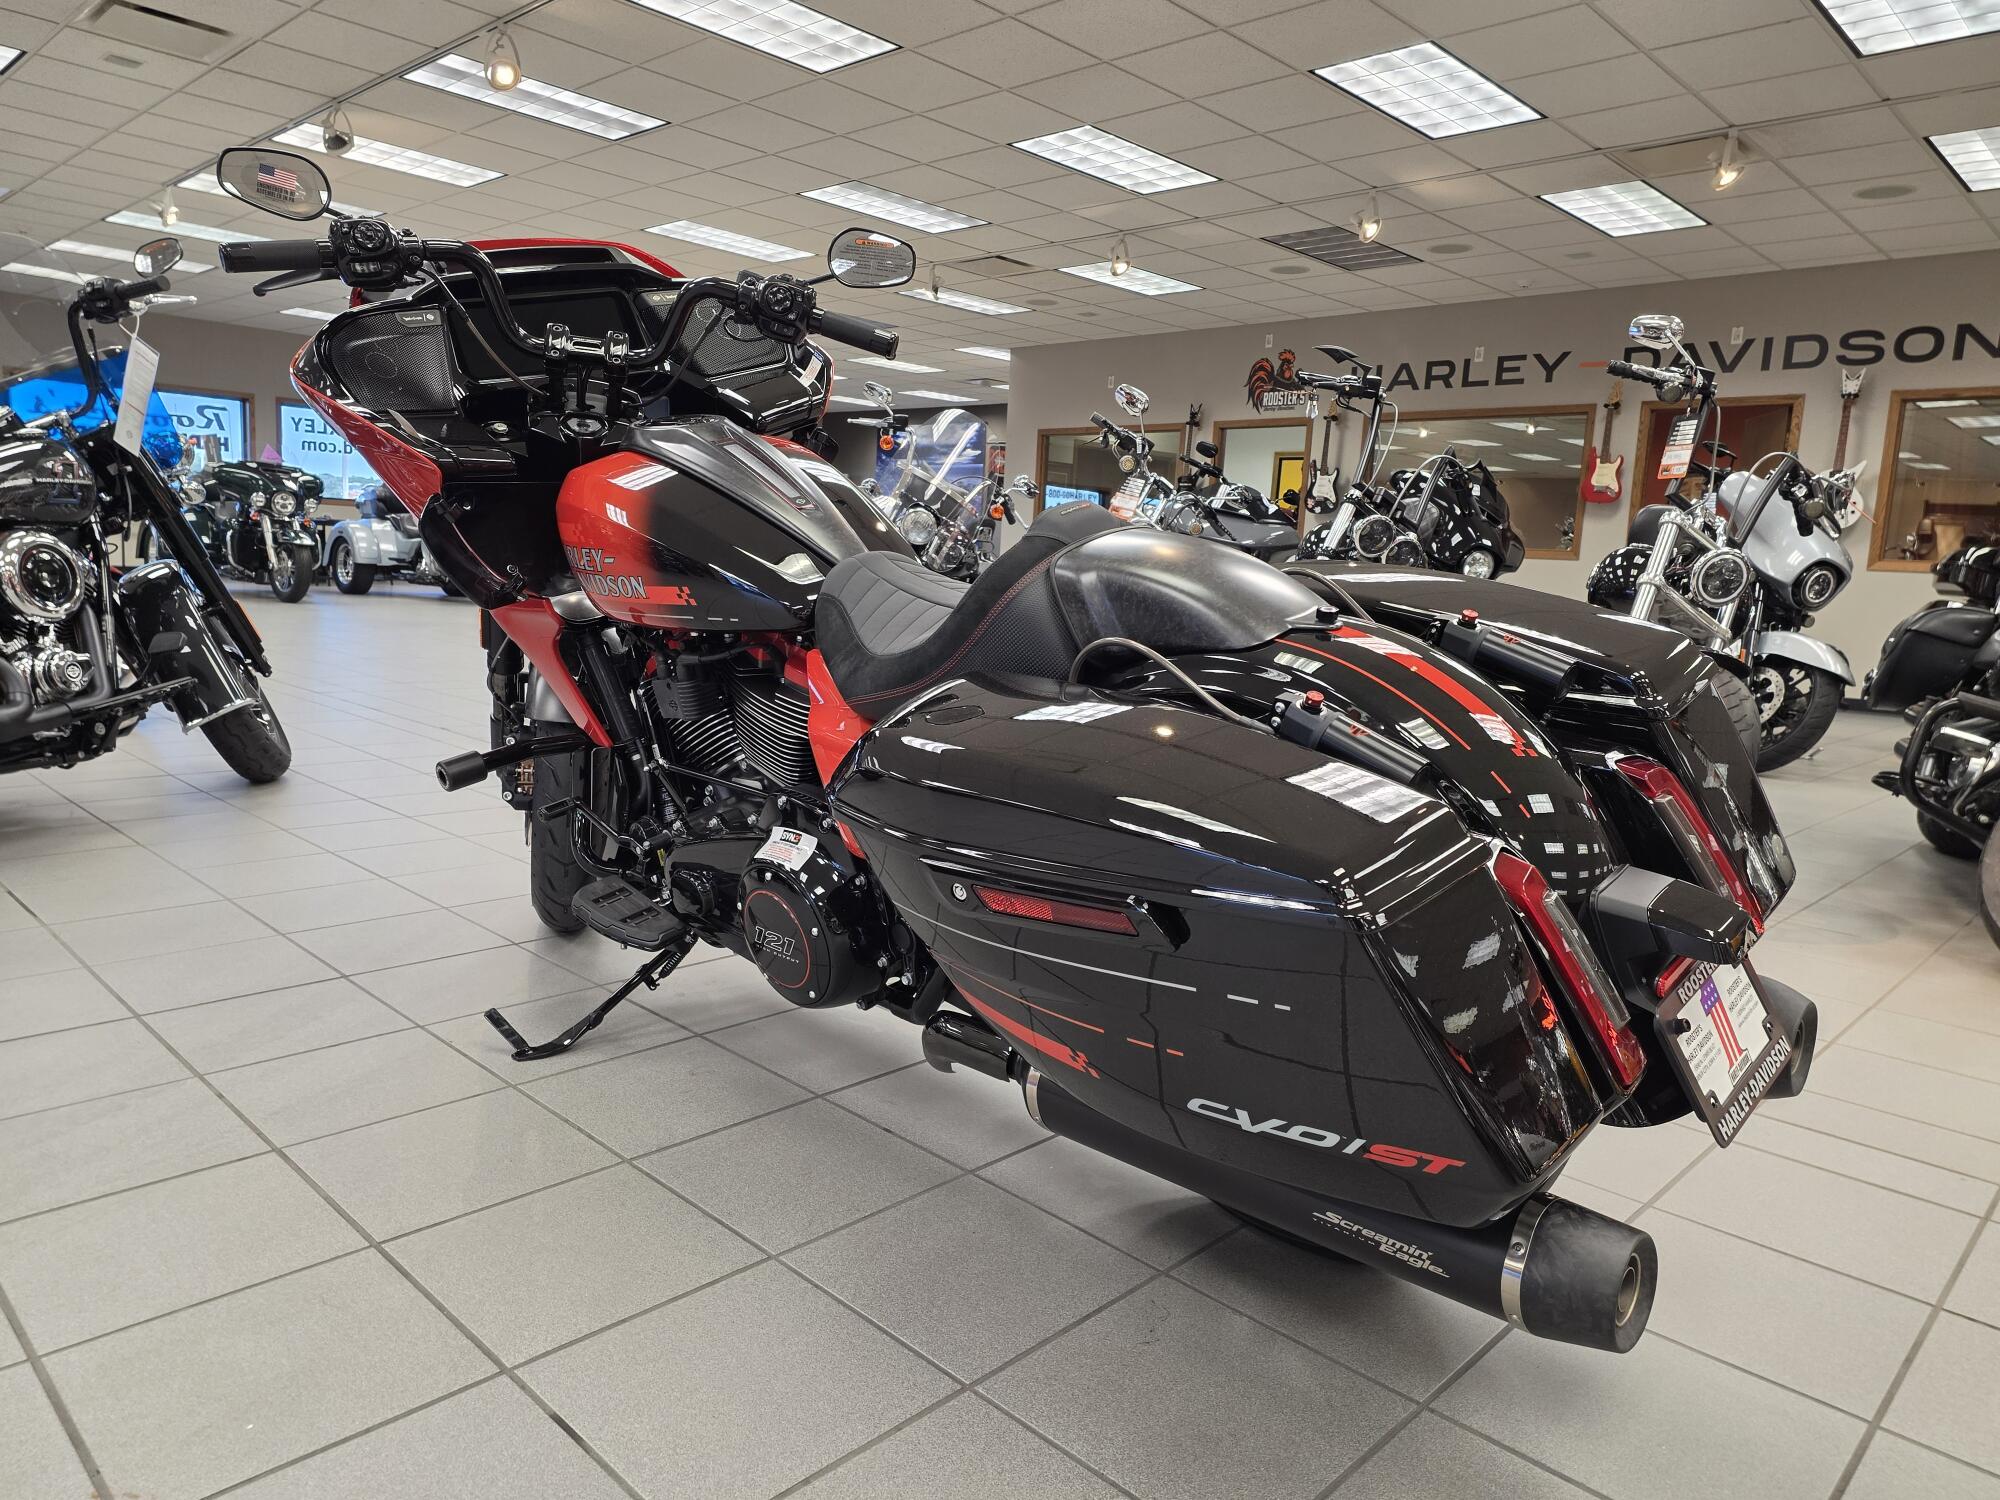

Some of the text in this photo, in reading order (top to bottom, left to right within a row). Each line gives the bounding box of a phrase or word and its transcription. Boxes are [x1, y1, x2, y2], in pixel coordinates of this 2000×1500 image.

[563, 545, 616, 572] RLEY-
[577, 572, 649, 599] VIDSON
[755, 926, 795, 955] 121
[1717, 1036, 1791, 1141] HARLEY-DAVIDSON
[1378, 1243, 1450, 1278] Eagle
